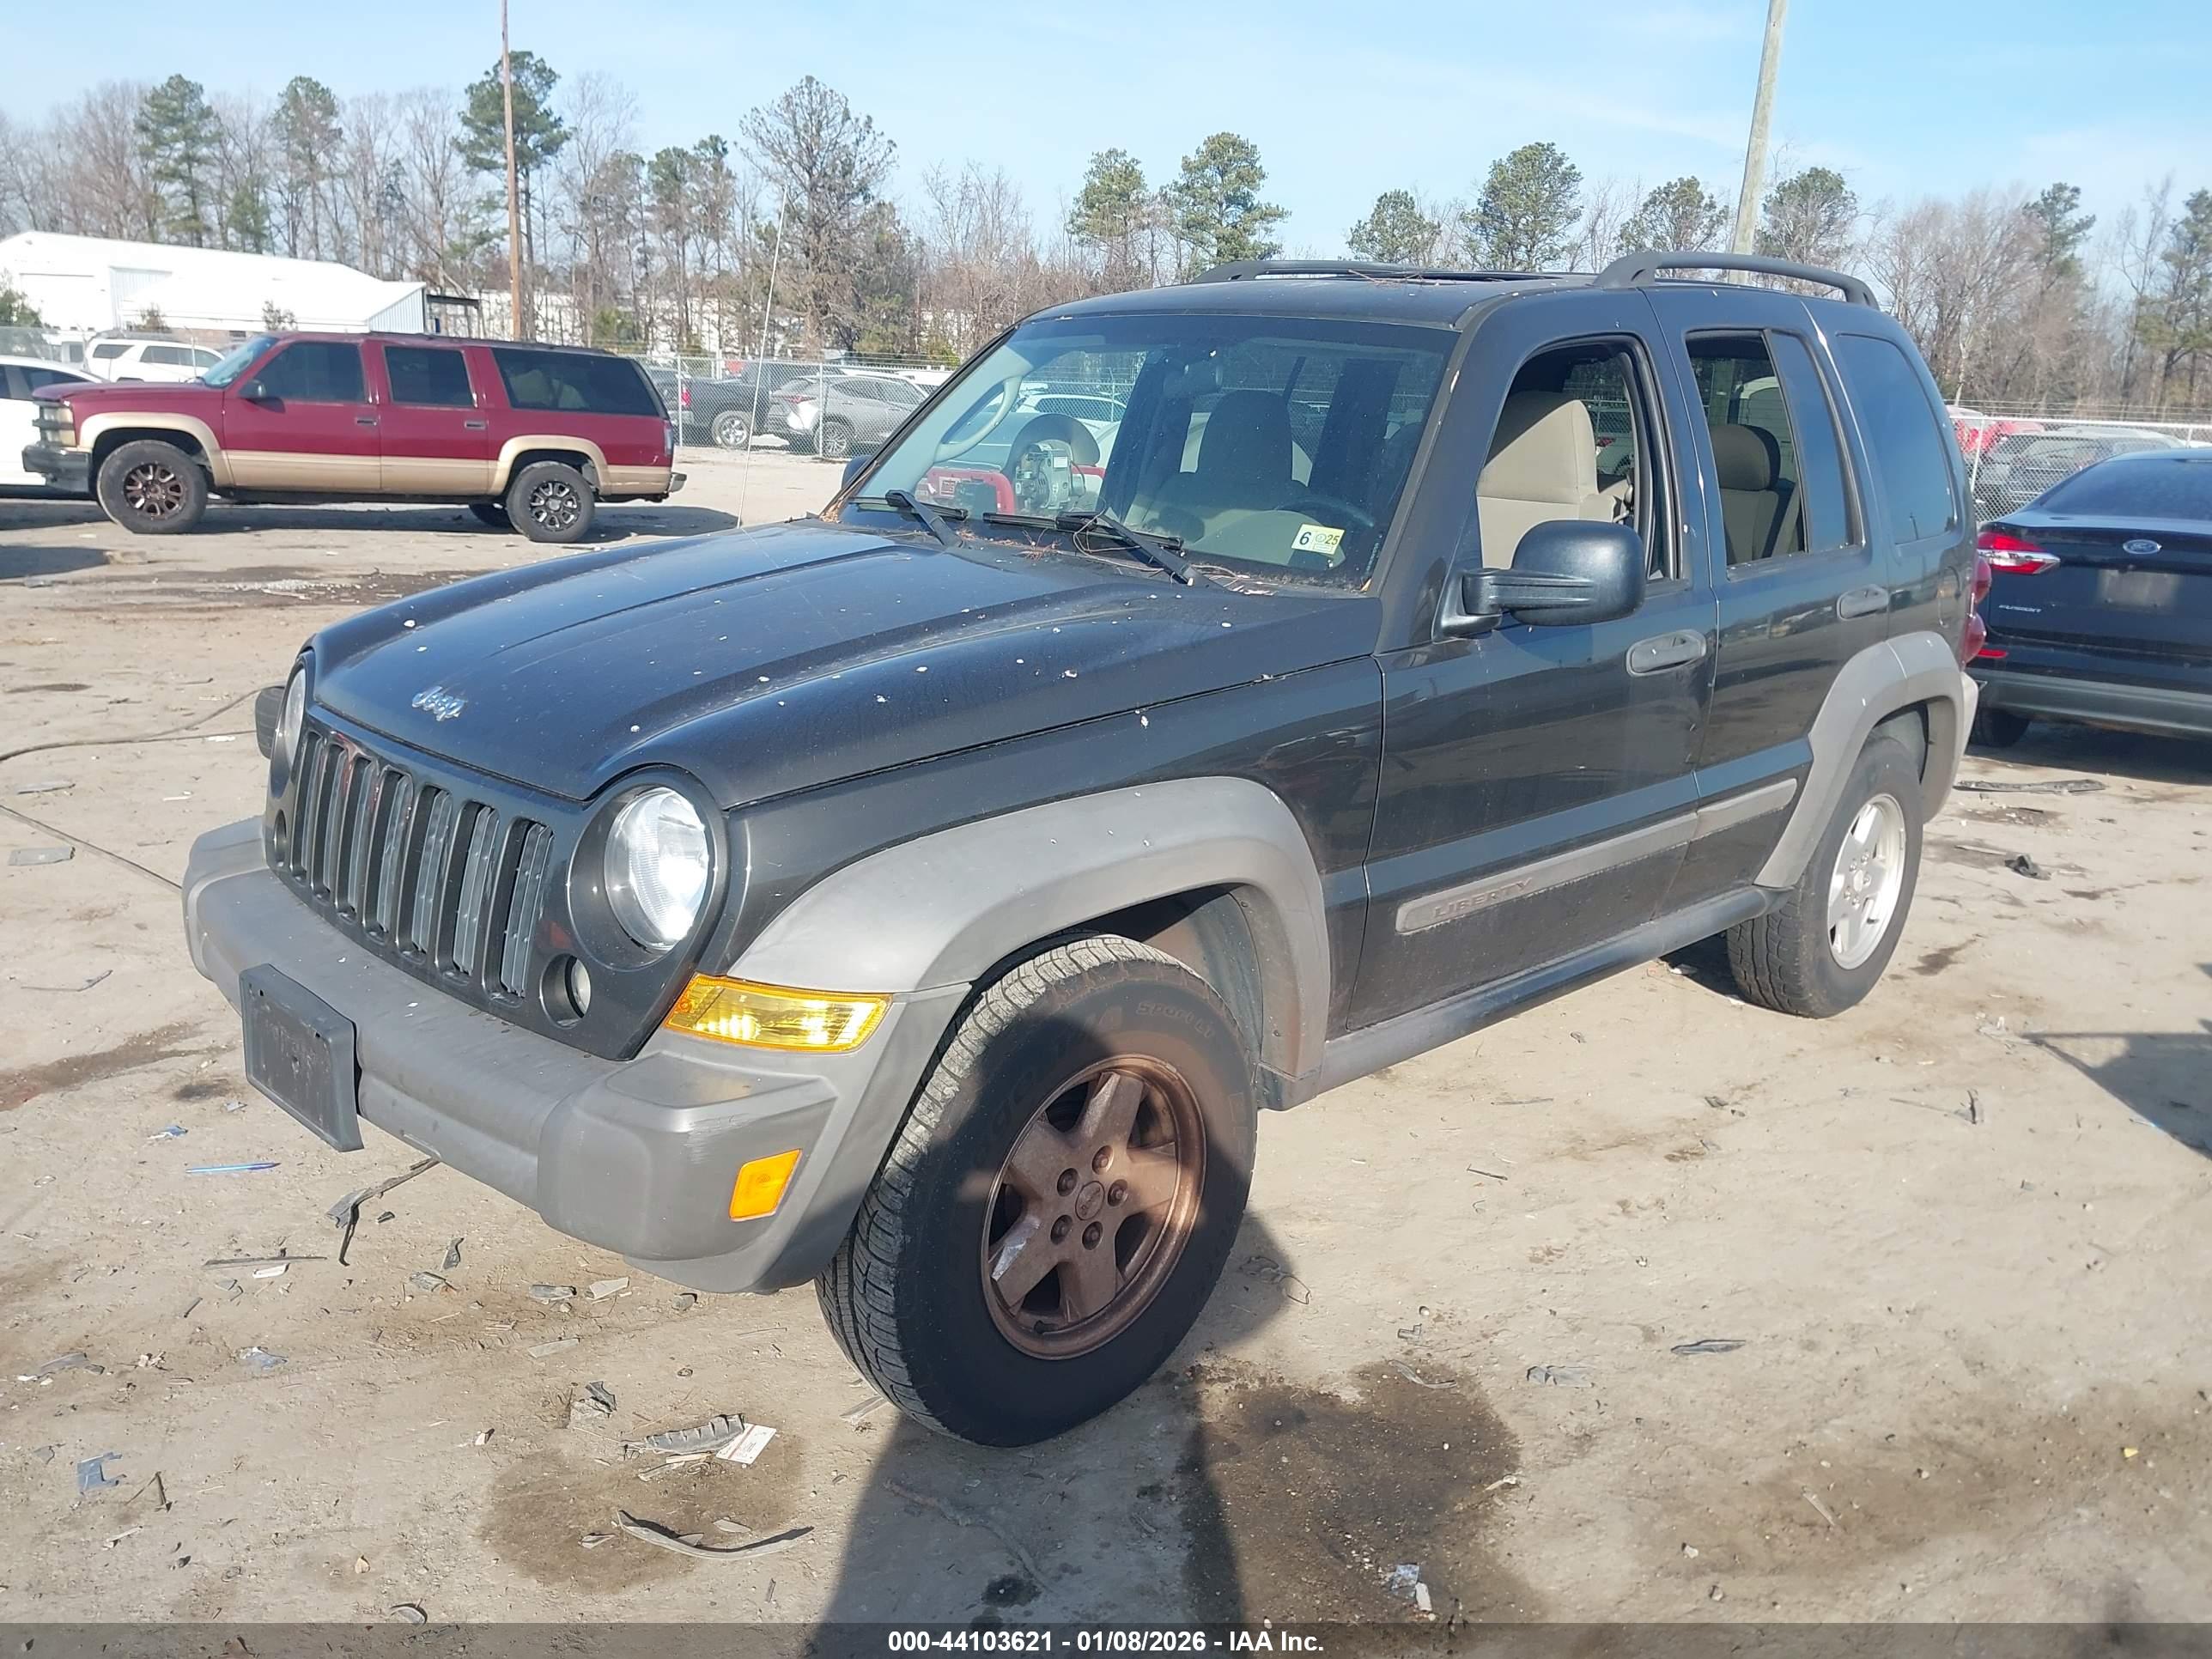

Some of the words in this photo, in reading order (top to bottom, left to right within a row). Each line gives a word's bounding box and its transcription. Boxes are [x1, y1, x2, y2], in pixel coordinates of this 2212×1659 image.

[1299, 531, 1311, 545] 6
[1325, 534, 1340, 545] 25
[1433, 877, 1533, 918] LIBERTY
